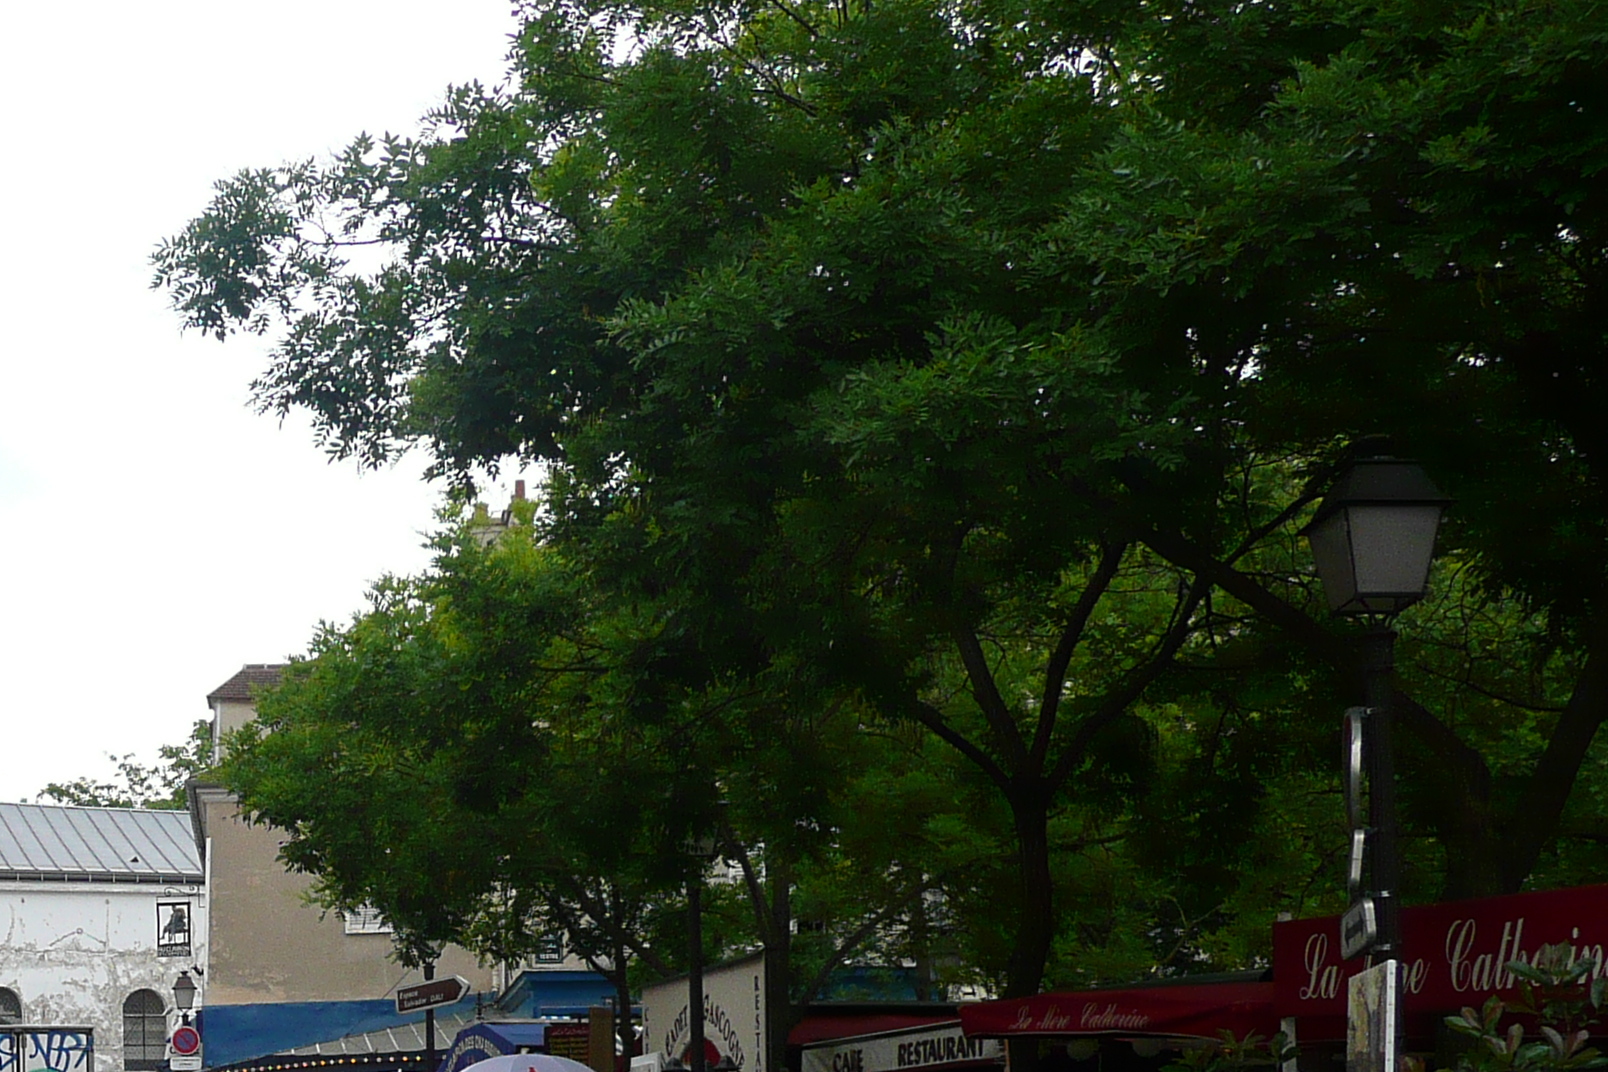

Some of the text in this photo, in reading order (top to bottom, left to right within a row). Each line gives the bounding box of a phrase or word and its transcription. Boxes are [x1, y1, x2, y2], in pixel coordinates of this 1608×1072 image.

[1299, 932, 1345, 1000] La
[1008, 1004, 1034, 1030] La
[1080, 1001, 1152, 1029] Catherine
[898, 1035, 984, 1067] RESTAURANT
